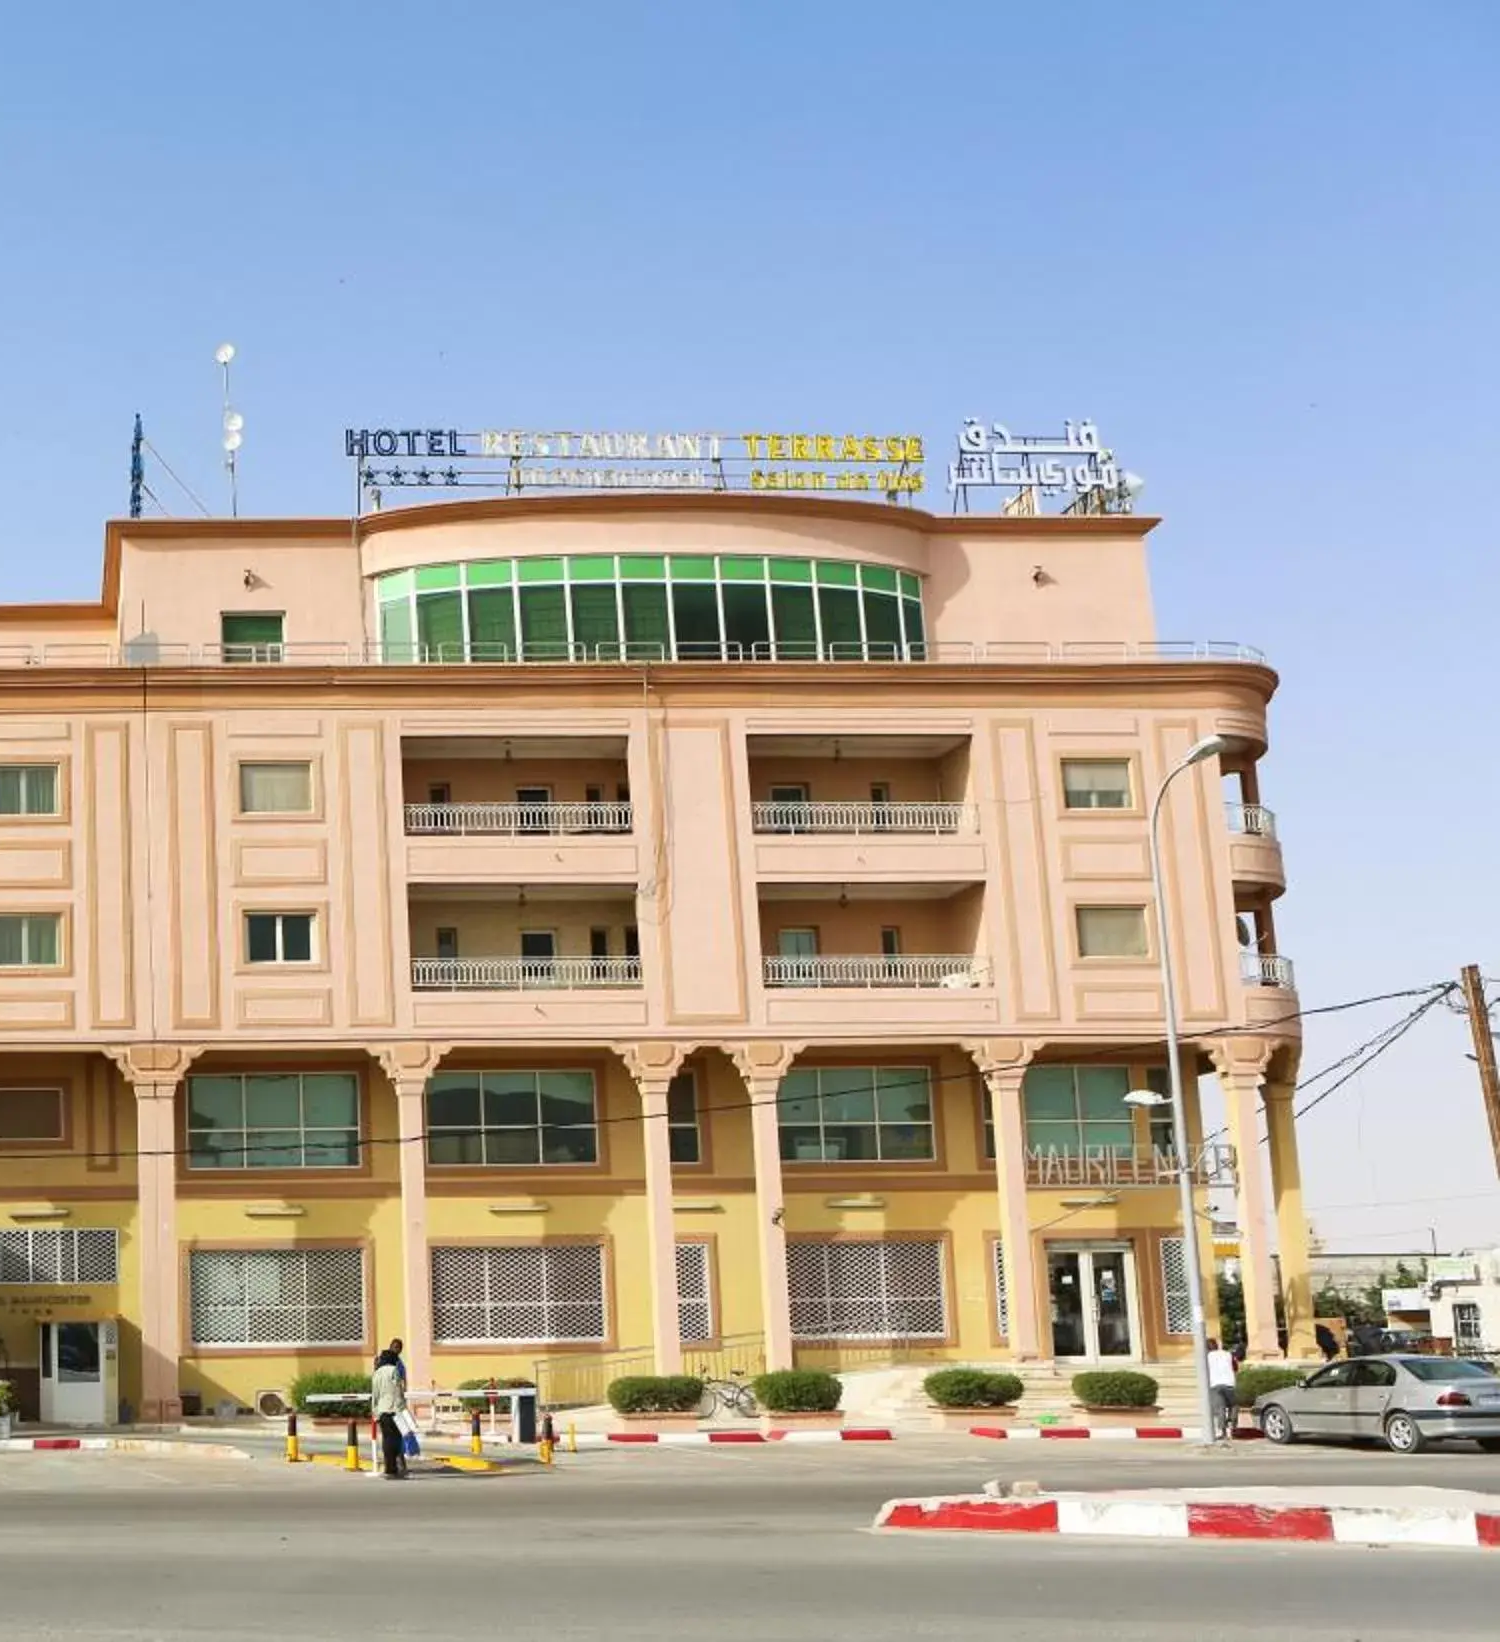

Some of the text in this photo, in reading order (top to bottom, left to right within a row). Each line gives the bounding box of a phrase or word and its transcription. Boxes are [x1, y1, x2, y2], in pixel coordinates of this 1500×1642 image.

[345, 429, 925, 463] HOTEL RESTAURANT TERRASSE
[958, 417, 1098, 454] فندق
